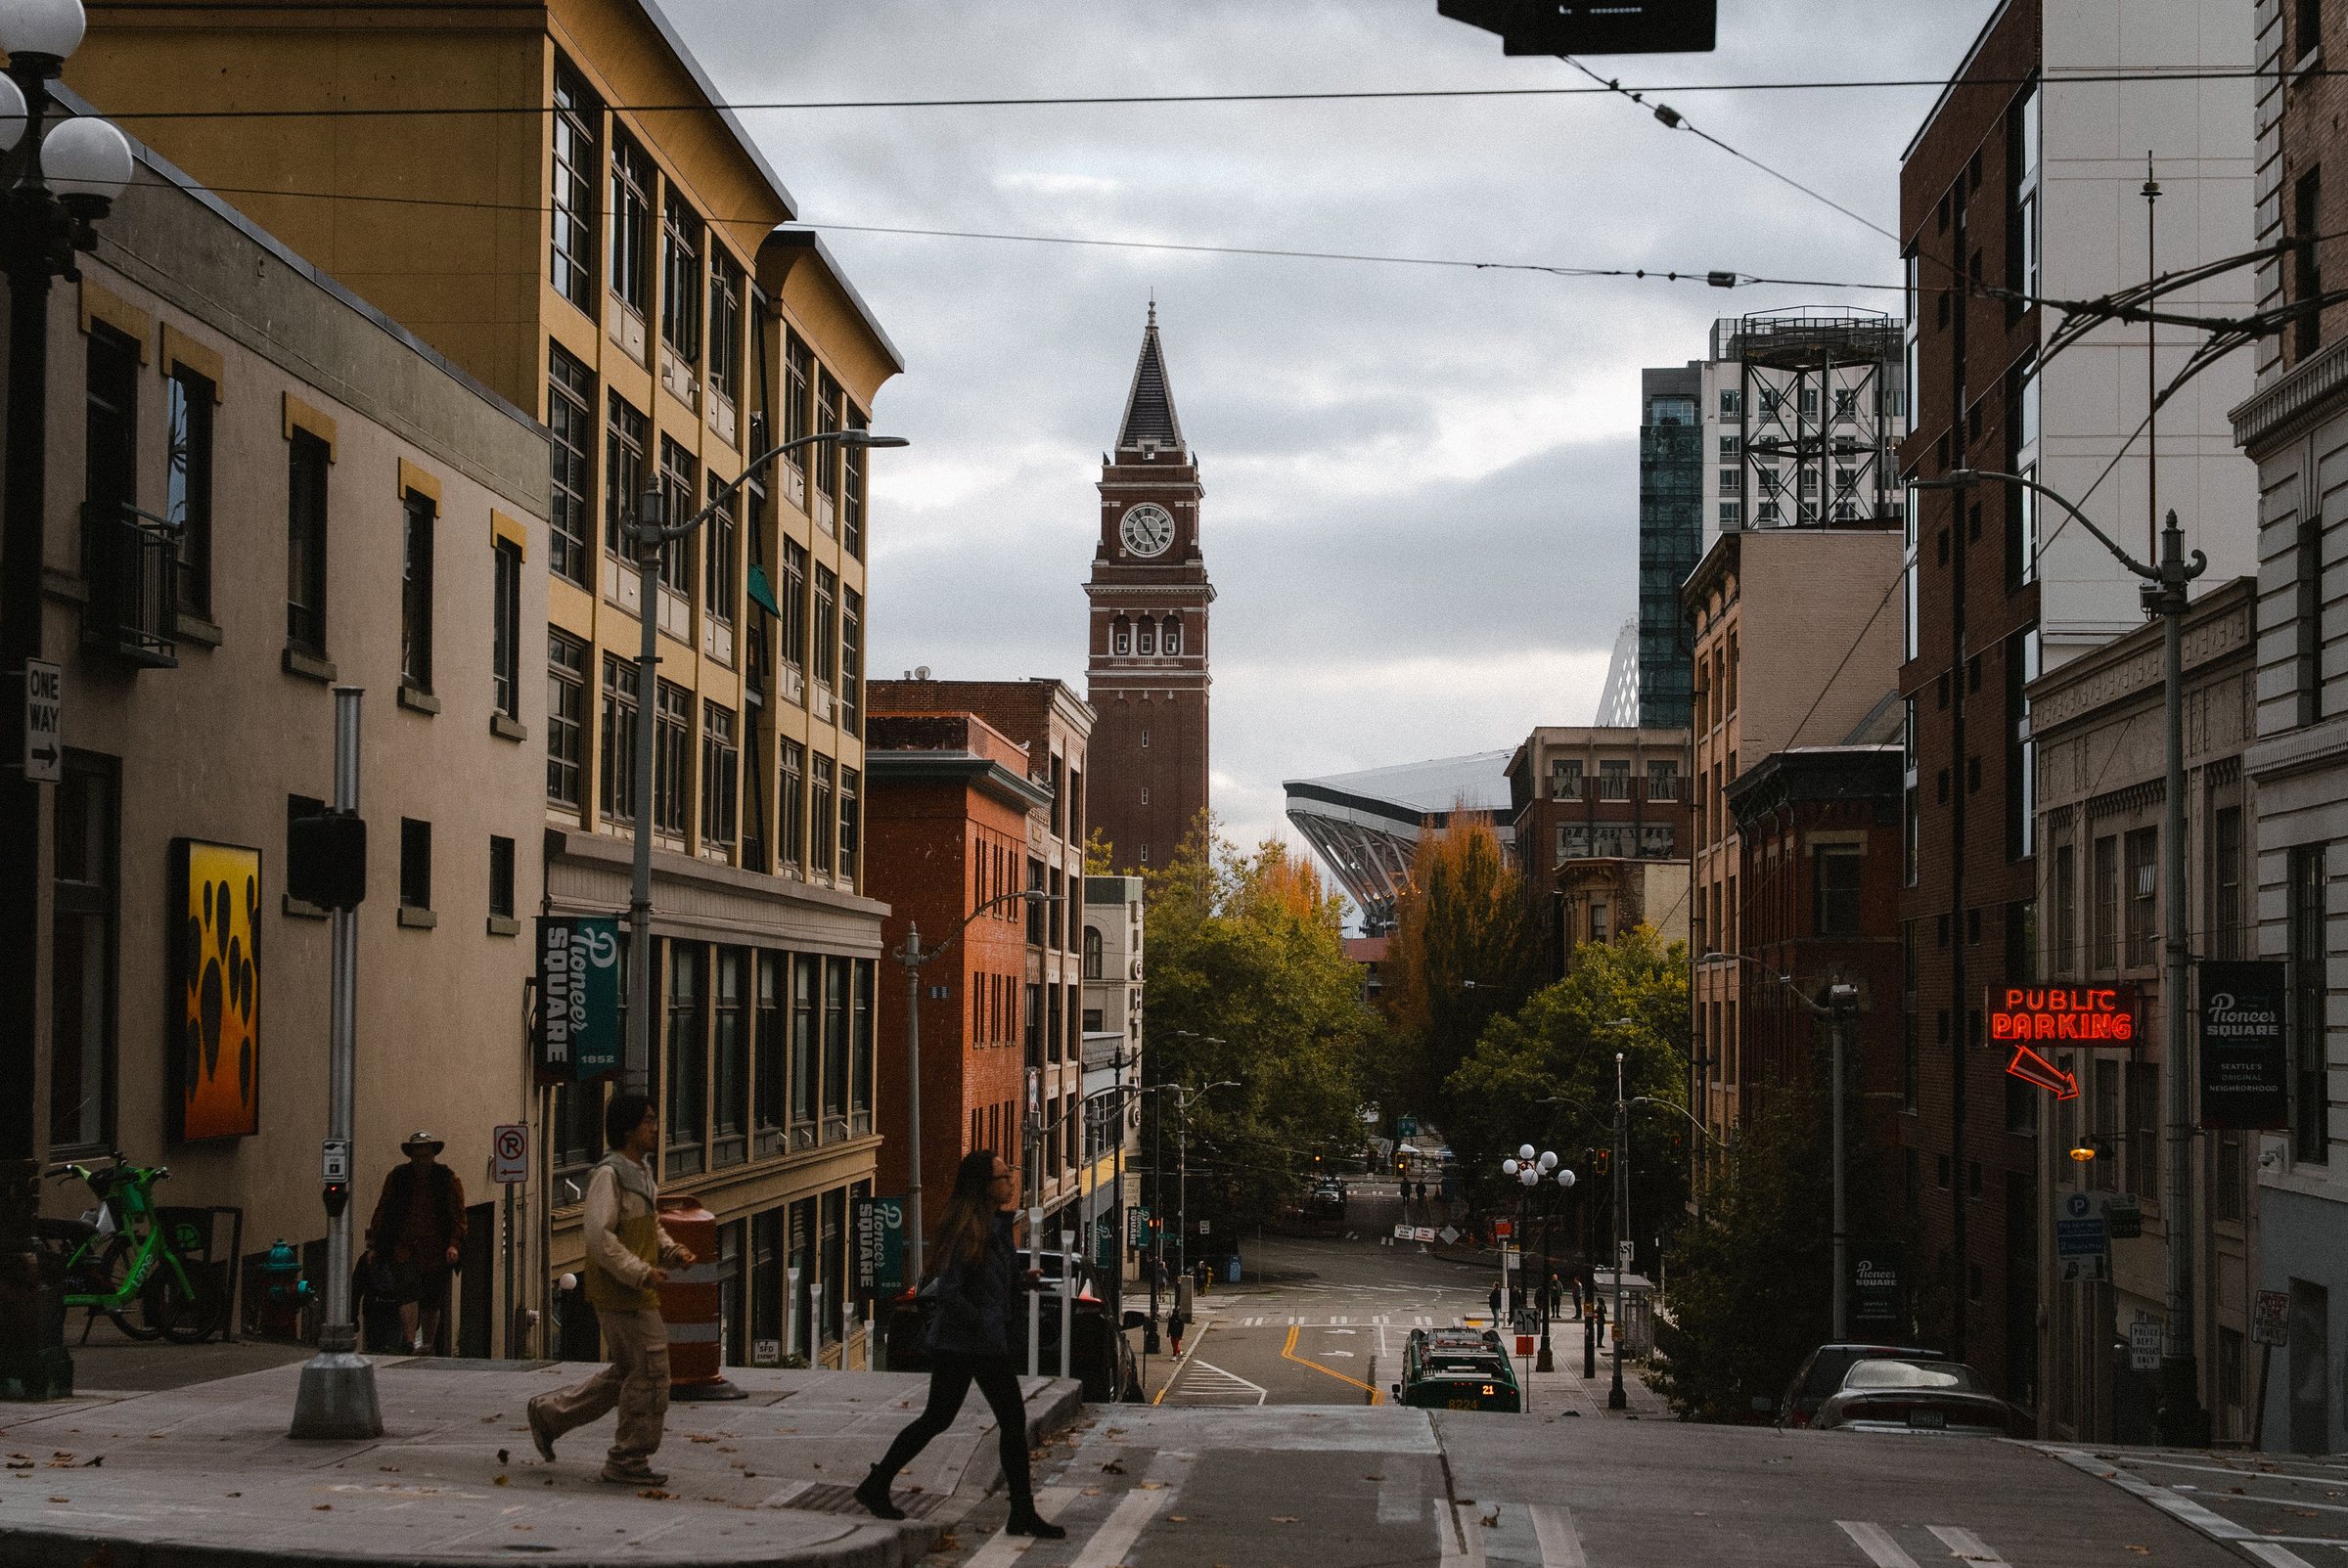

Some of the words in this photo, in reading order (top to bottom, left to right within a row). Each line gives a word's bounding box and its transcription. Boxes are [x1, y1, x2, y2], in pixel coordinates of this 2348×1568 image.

[30, 669, 59, 699] ONE
[29, 703, 59, 734] WAY
[544, 927, 568, 1062] SQUARE
[569, 927, 616, 1034] Pioneer
[2006, 989, 2116, 1011] PUBLIC
[2208, 992, 2278, 1023] Pioneer
[1992, 1012, 2132, 1040] PARKING
[2206, 1024, 2279, 1037] SQUARE
[580, 1054, 615, 1064] 1852
[2073, 1198, 2085, 1214] P
[858, 1203, 874, 1287] SQUARE
[874, 1203, 902, 1269] Pioneer
[131, 1253, 155, 1287] Lime
[1855, 1278, 1897, 1287] SQUARE
[1856, 1260, 1896, 1278] Pioneer
[1481, 1385, 1494, 1395] 21
[1448, 1399, 1479, 1411] 8224
